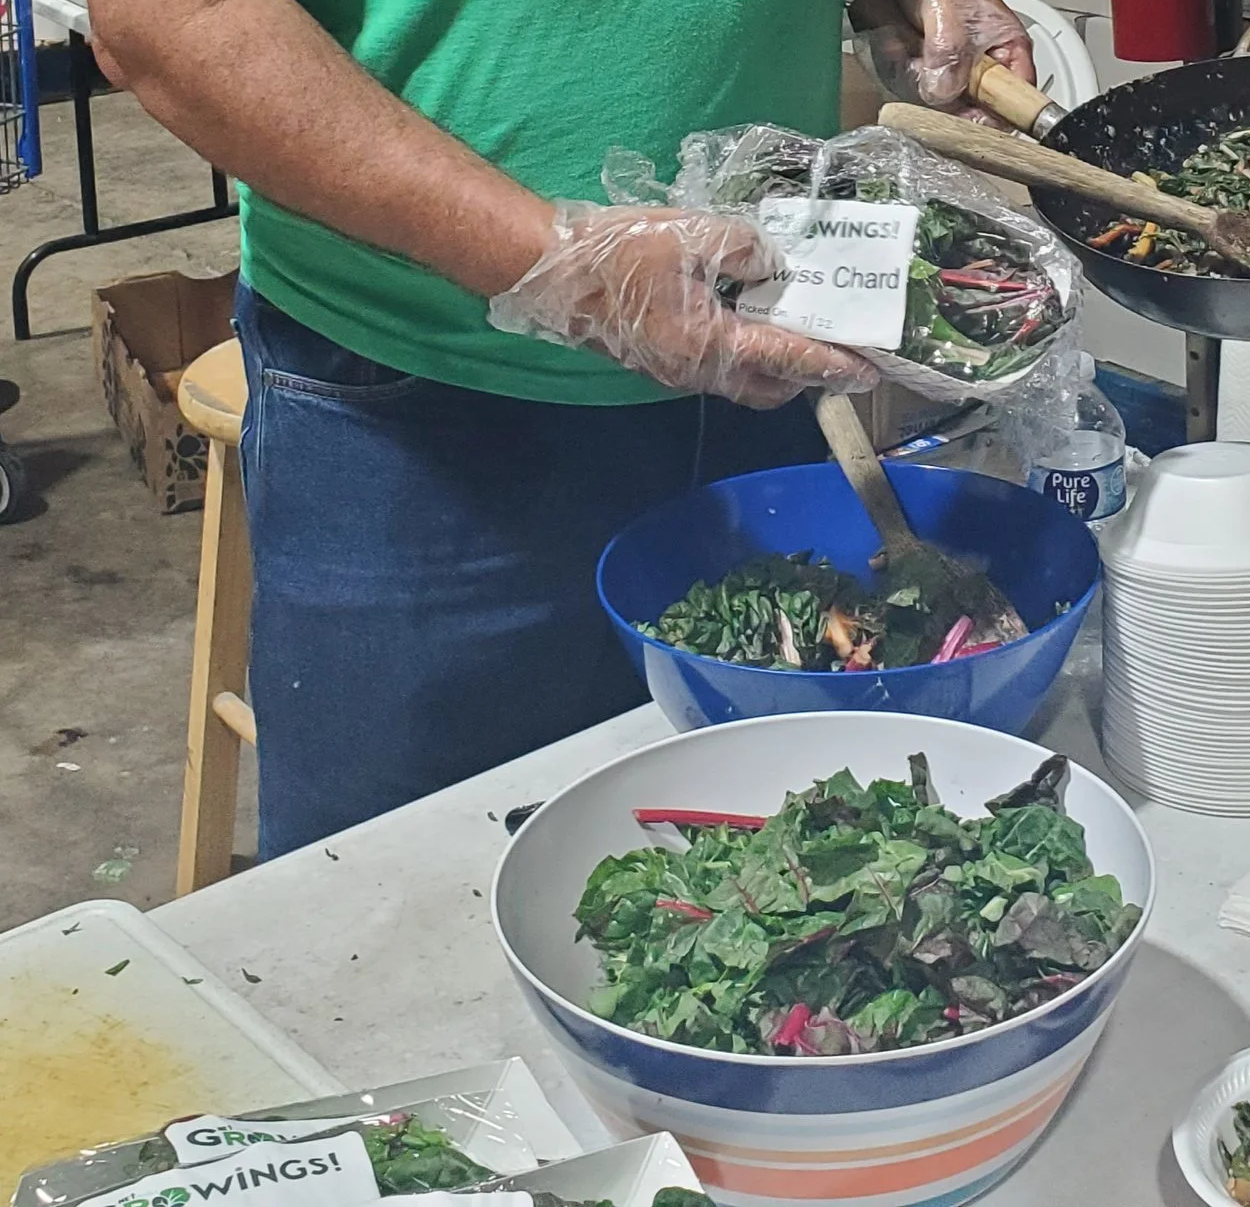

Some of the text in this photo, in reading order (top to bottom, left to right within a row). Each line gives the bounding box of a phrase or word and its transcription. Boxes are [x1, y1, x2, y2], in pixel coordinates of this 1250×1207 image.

[772, 265, 901, 290] wiss Chard
[1052, 472, 1092, 489] Pure
[1057, 488, 1087, 507] Life
